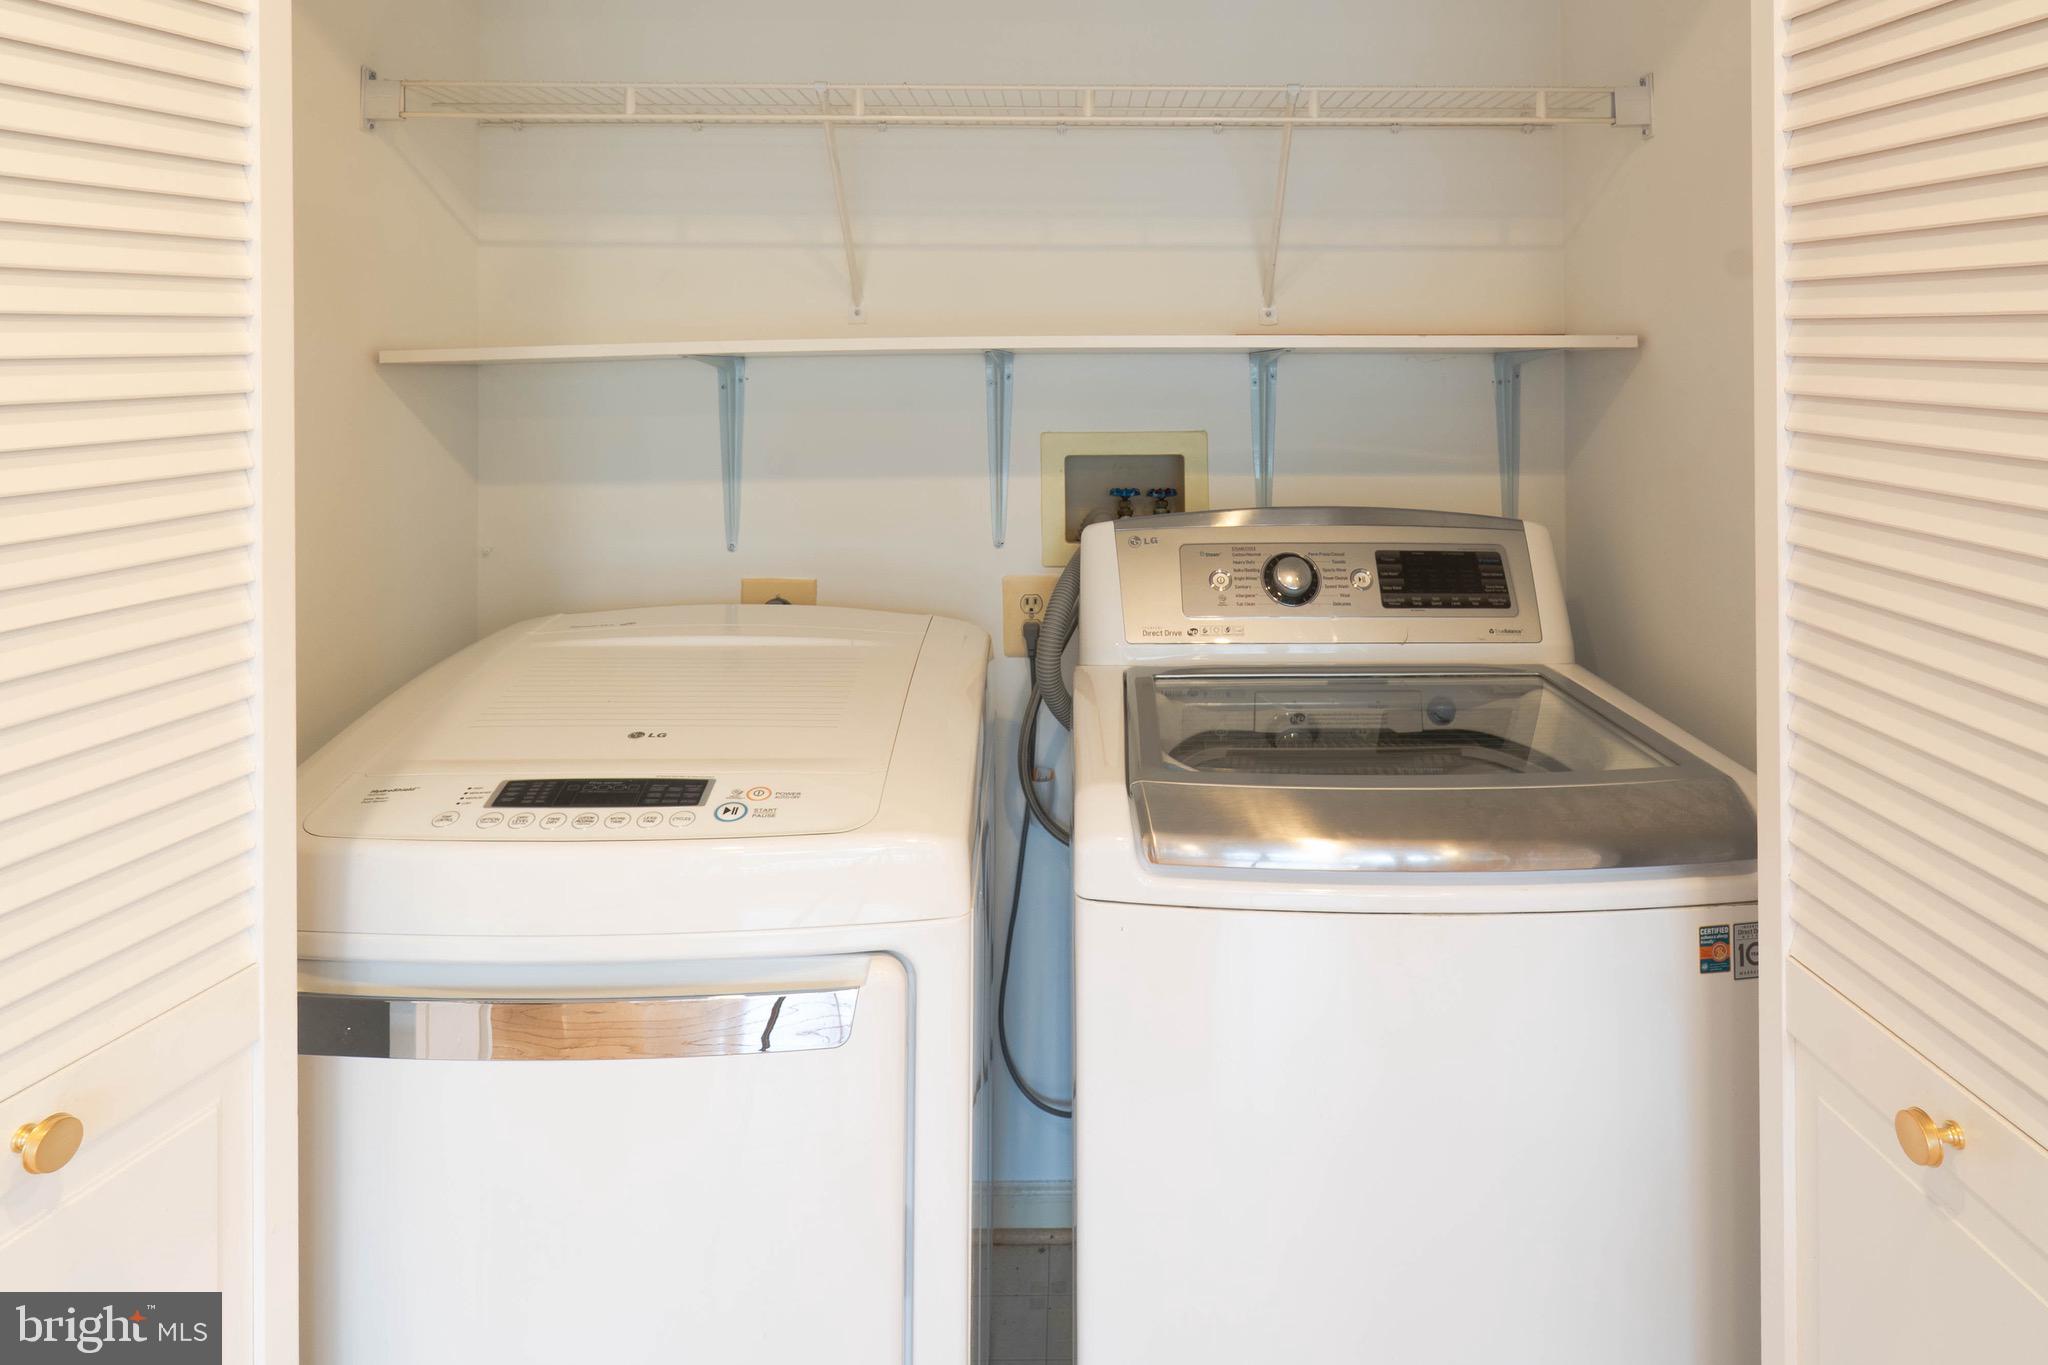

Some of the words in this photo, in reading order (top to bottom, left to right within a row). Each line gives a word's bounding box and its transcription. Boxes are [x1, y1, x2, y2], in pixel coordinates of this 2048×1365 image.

[1143, 536, 1158, 545] LG
[1142, 629, 1163, 637] Direct
[1165, 629, 1182, 637] Drive
[1700, 926, 1729, 935] CERTIFIED
